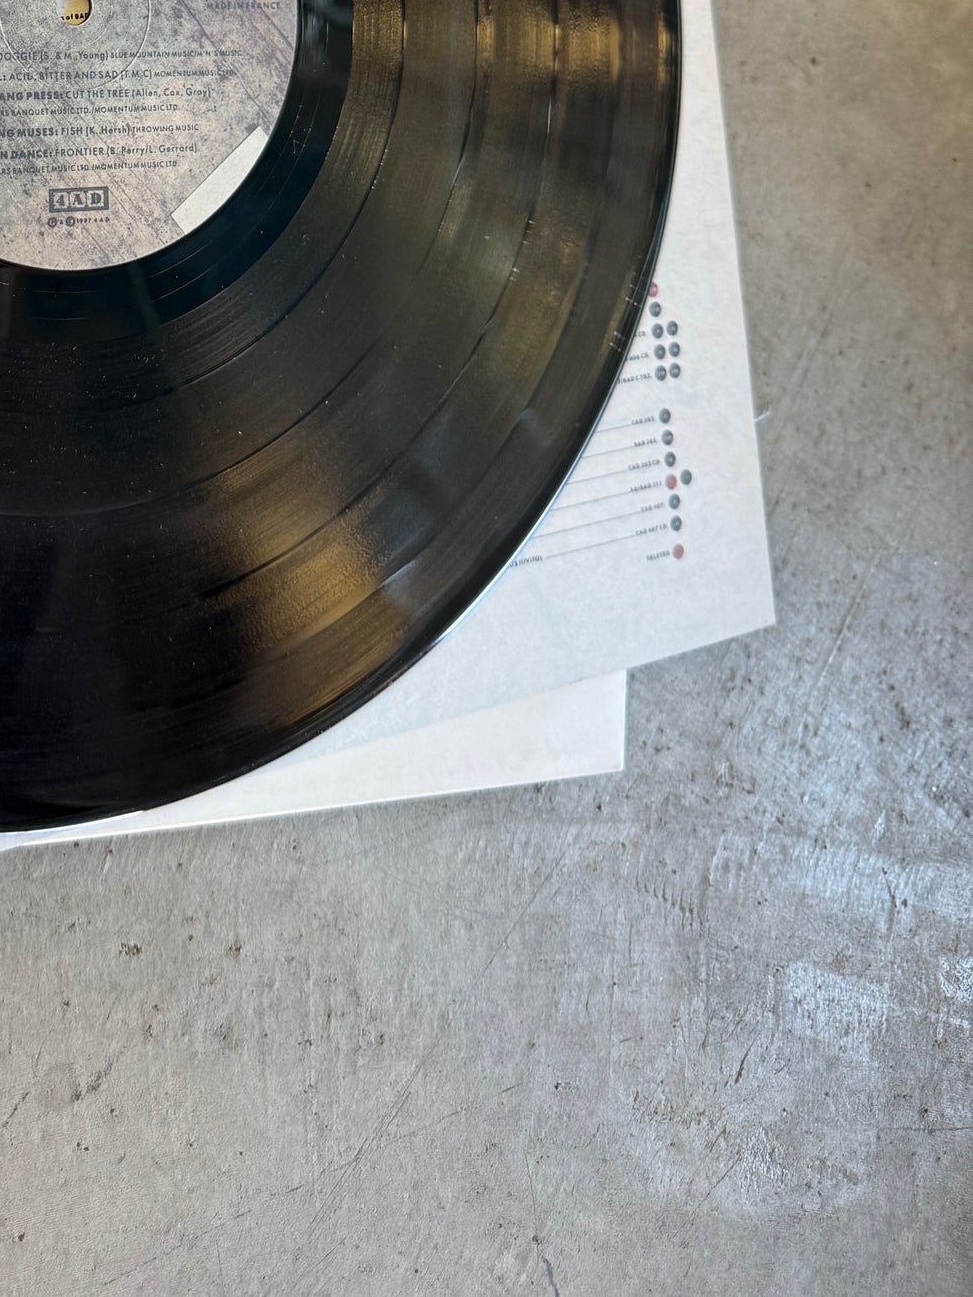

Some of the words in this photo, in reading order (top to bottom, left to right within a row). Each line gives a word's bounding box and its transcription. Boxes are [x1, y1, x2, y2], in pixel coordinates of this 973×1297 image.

[206, 2, 232, 11] MADE
[246, 1, 281, 10] FRANCE
[55, 52, 62, 61] &
[78, 50, 109, 63] Young)
[110, 51, 128, 60] BLUE
[129, 51, 171, 59] MOUNTAIN
[8, 72, 37, 82] ACID,
[39, 71, 72, 81] BITTER
[74, 70, 96, 80] AND
[98, 70, 119, 79] SAD
[154, 70, 198, 78] MOMENTUM
[26, 90, 64, 101] PRESS:
[65, 90, 85, 100] CUT
[87, 89, 104, 99] THE
[107, 89, 130, 98] TREE
[185, 86, 212, 99] Gray)
[10, 108, 49, 118] BANQUET
[50, 107, 75, 115] MUSIC
[141, 104, 165, 113] MUSIC
[16, 127, 59, 137] MUSES:
[61, 126, 83, 136] FISH
[101, 124, 130, 136] Hersh)
[132, 124, 174, 134] THROWING
[175, 123, 199, 132] MUSIC
[10, 149, 53, 160] DANCE:
[55, 146, 105, 158] FRONTIER
[158, 142, 198, 154] Gerrard)
[12, 165, 50, 175] BANQUET
[51, 163, 76, 173] MUSIC
[140, 160, 164, 170] MUSIC
[53, 190, 104, 209] 4AD
